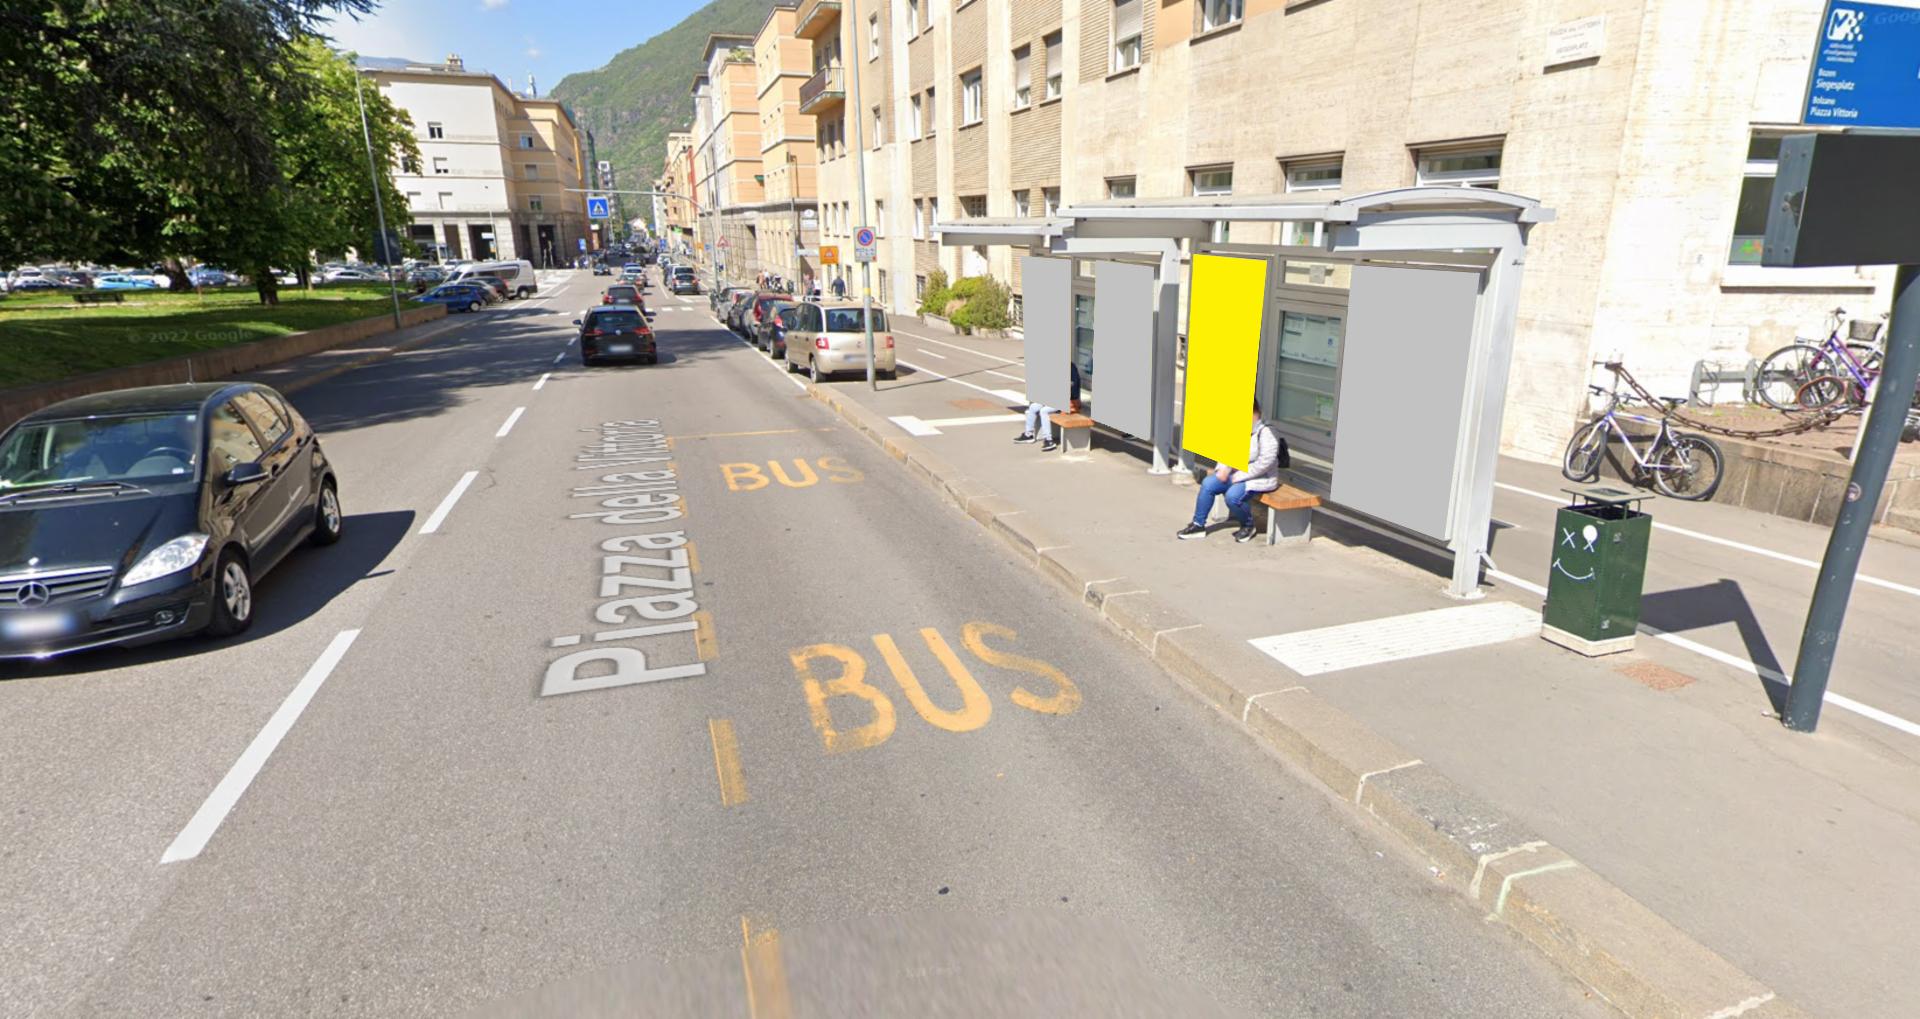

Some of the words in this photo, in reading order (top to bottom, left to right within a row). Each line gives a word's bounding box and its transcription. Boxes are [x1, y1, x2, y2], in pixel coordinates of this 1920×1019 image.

[1815, 78, 1855, 91] Siegesplatz
[1810, 106, 1832, 117] Piazza
[1832, 107, 1858, 118] Vittoria
[719, 457, 865, 492] BUS
[790, 620, 1082, 754] BUS
